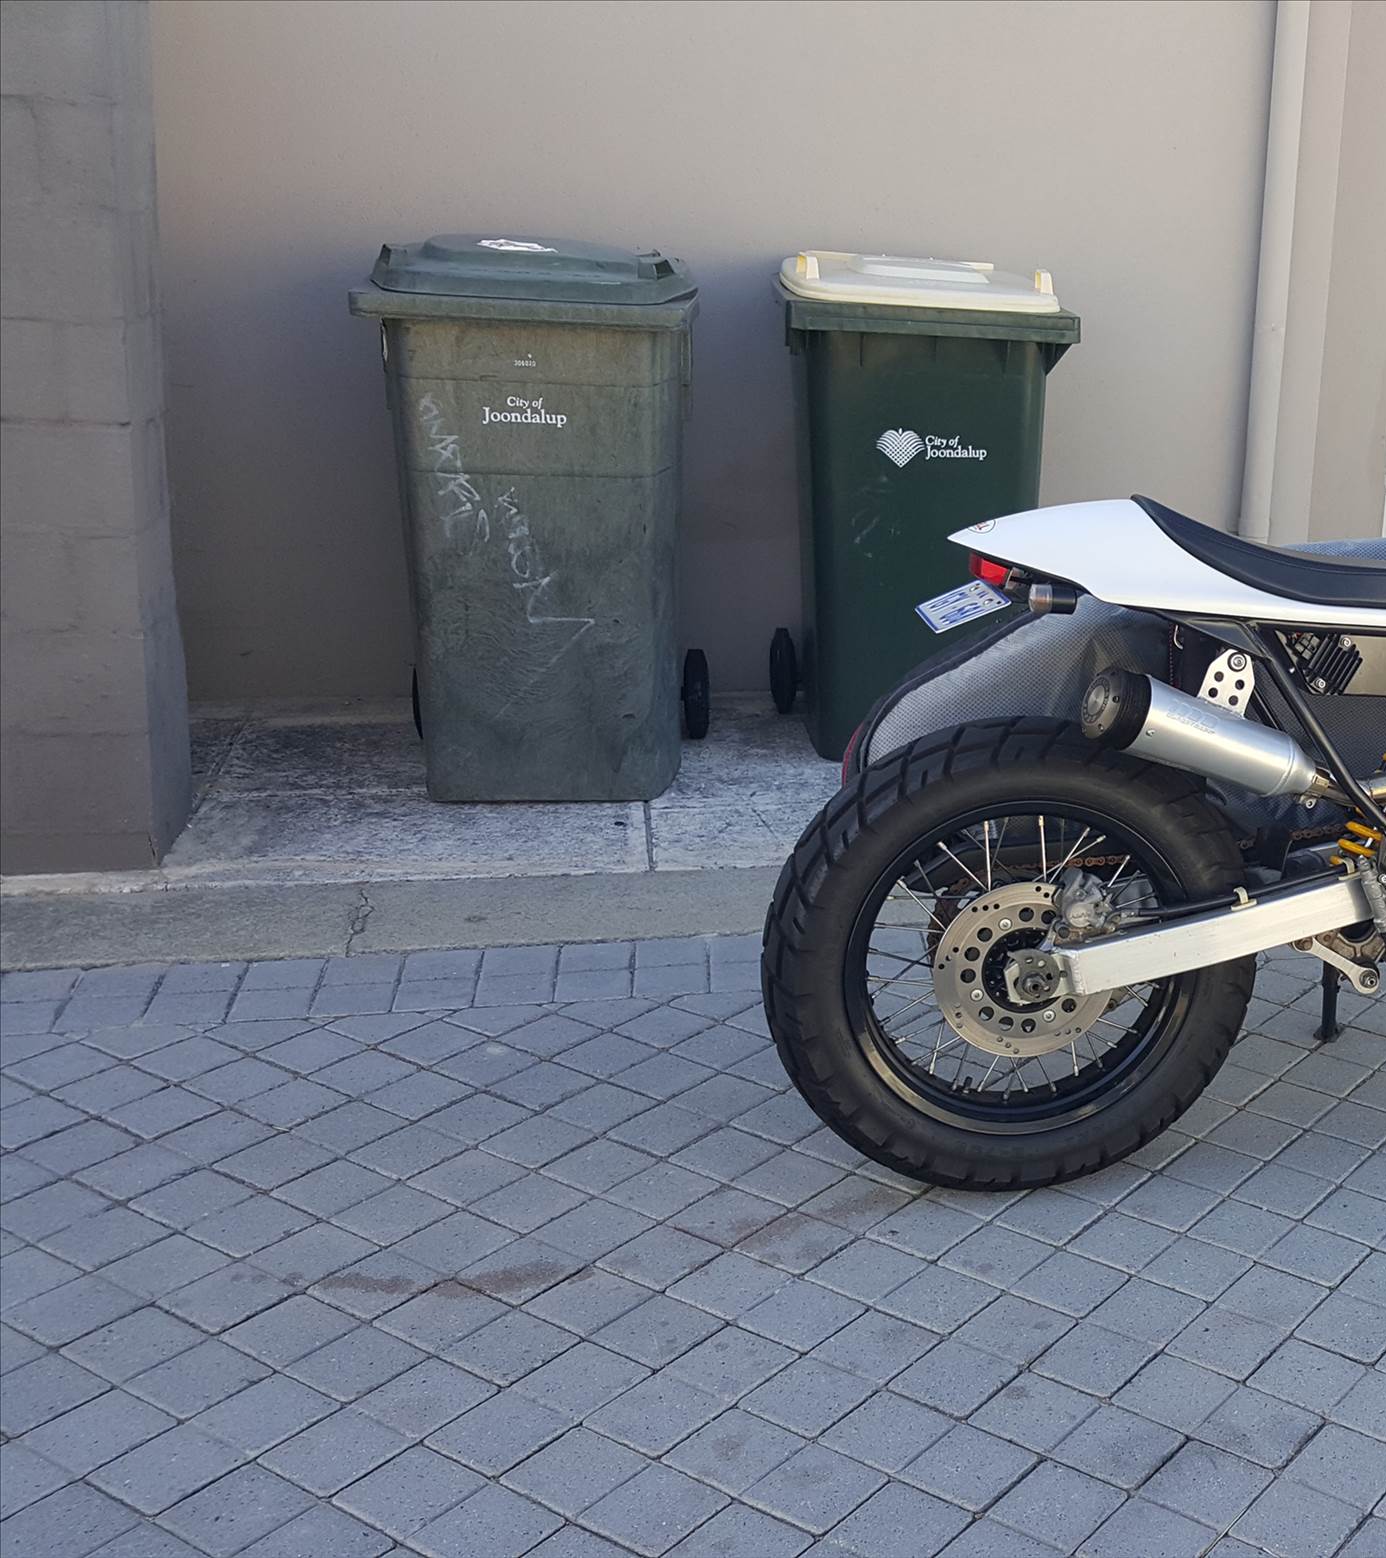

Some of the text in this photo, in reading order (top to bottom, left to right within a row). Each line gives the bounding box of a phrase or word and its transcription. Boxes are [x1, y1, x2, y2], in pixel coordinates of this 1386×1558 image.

[507, 396, 544, 409] City of
[482, 406, 567, 428] Joondalup
[925, 435, 960, 448] City of
[926, 445, 988, 461] Joondalup
